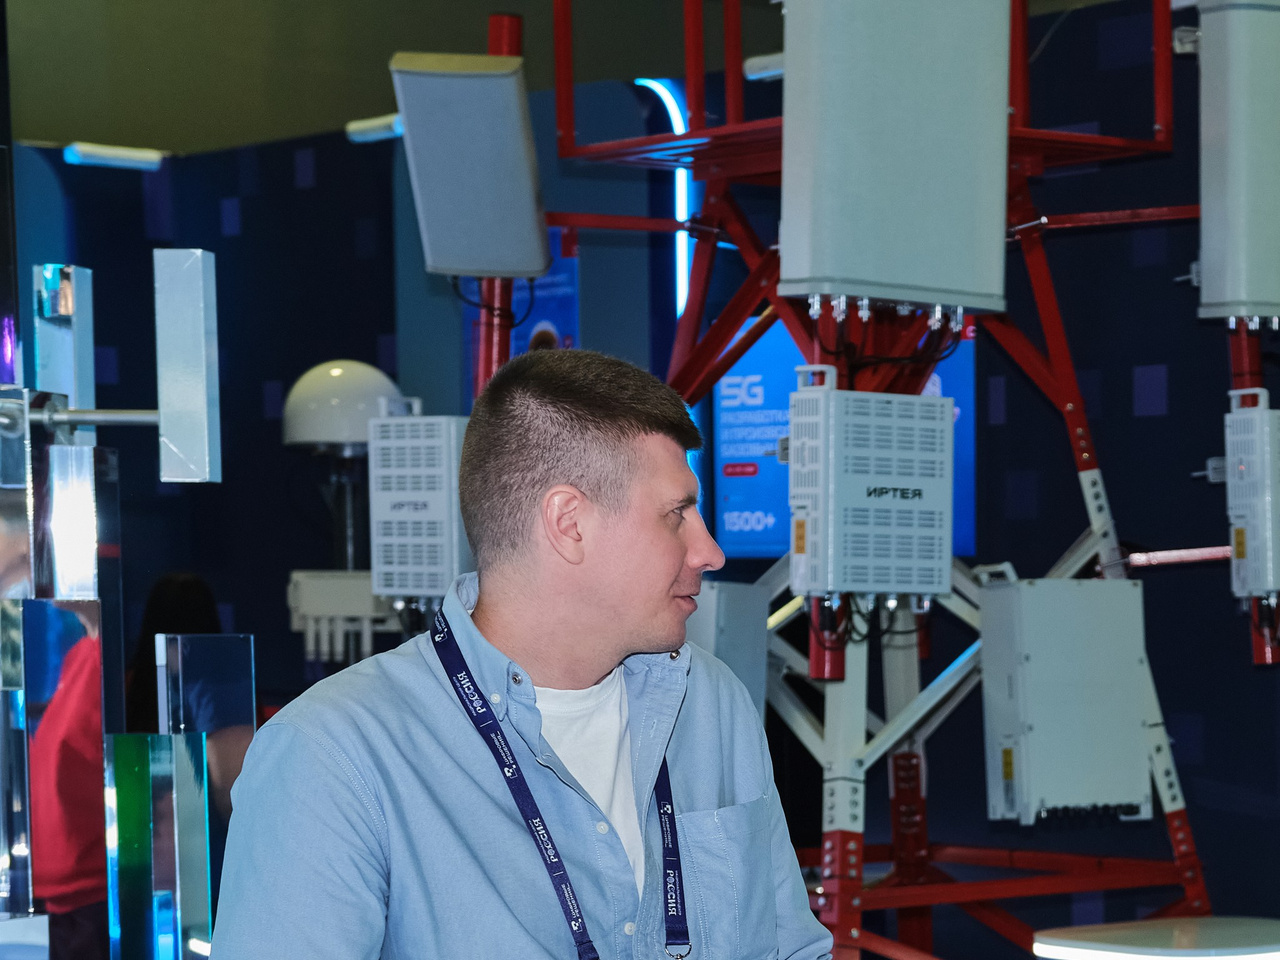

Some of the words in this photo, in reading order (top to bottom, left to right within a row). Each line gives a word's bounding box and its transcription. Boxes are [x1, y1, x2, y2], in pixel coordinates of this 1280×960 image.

[720, 375, 764, 407] 5G
[866, 486, 923, 500] ИРТЕЯ
[723, 511, 776, 531] 1500+
[457, 671, 486, 714] РОССИЯ
[532, 818, 558, 862] РОССИЯ
[666, 870, 676, 916] РОССИЯ
